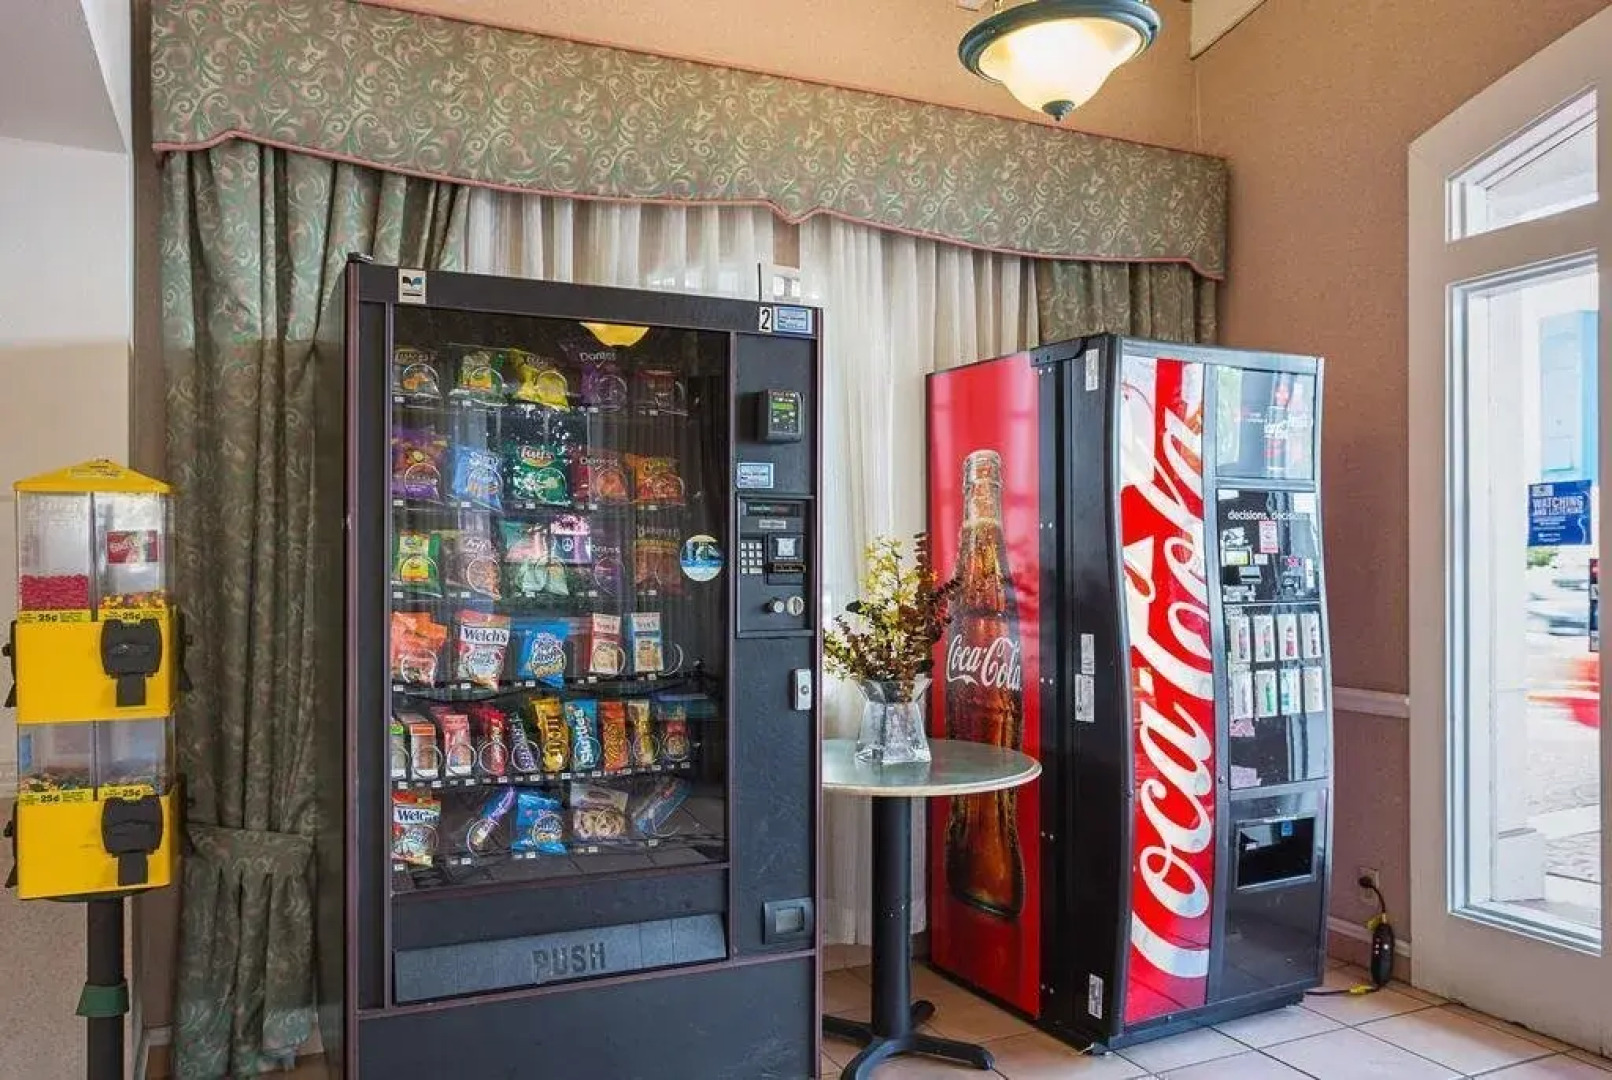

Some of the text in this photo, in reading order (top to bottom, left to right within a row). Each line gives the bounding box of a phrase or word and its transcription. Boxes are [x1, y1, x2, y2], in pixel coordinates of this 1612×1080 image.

[761, 308, 771, 330] 2
[1532, 496, 1584, 509] WATCHING
[1227, 509, 1268, 522] decisions,
[464, 627, 506, 642] Welch's
[532, 942, 607, 976] PUSH
